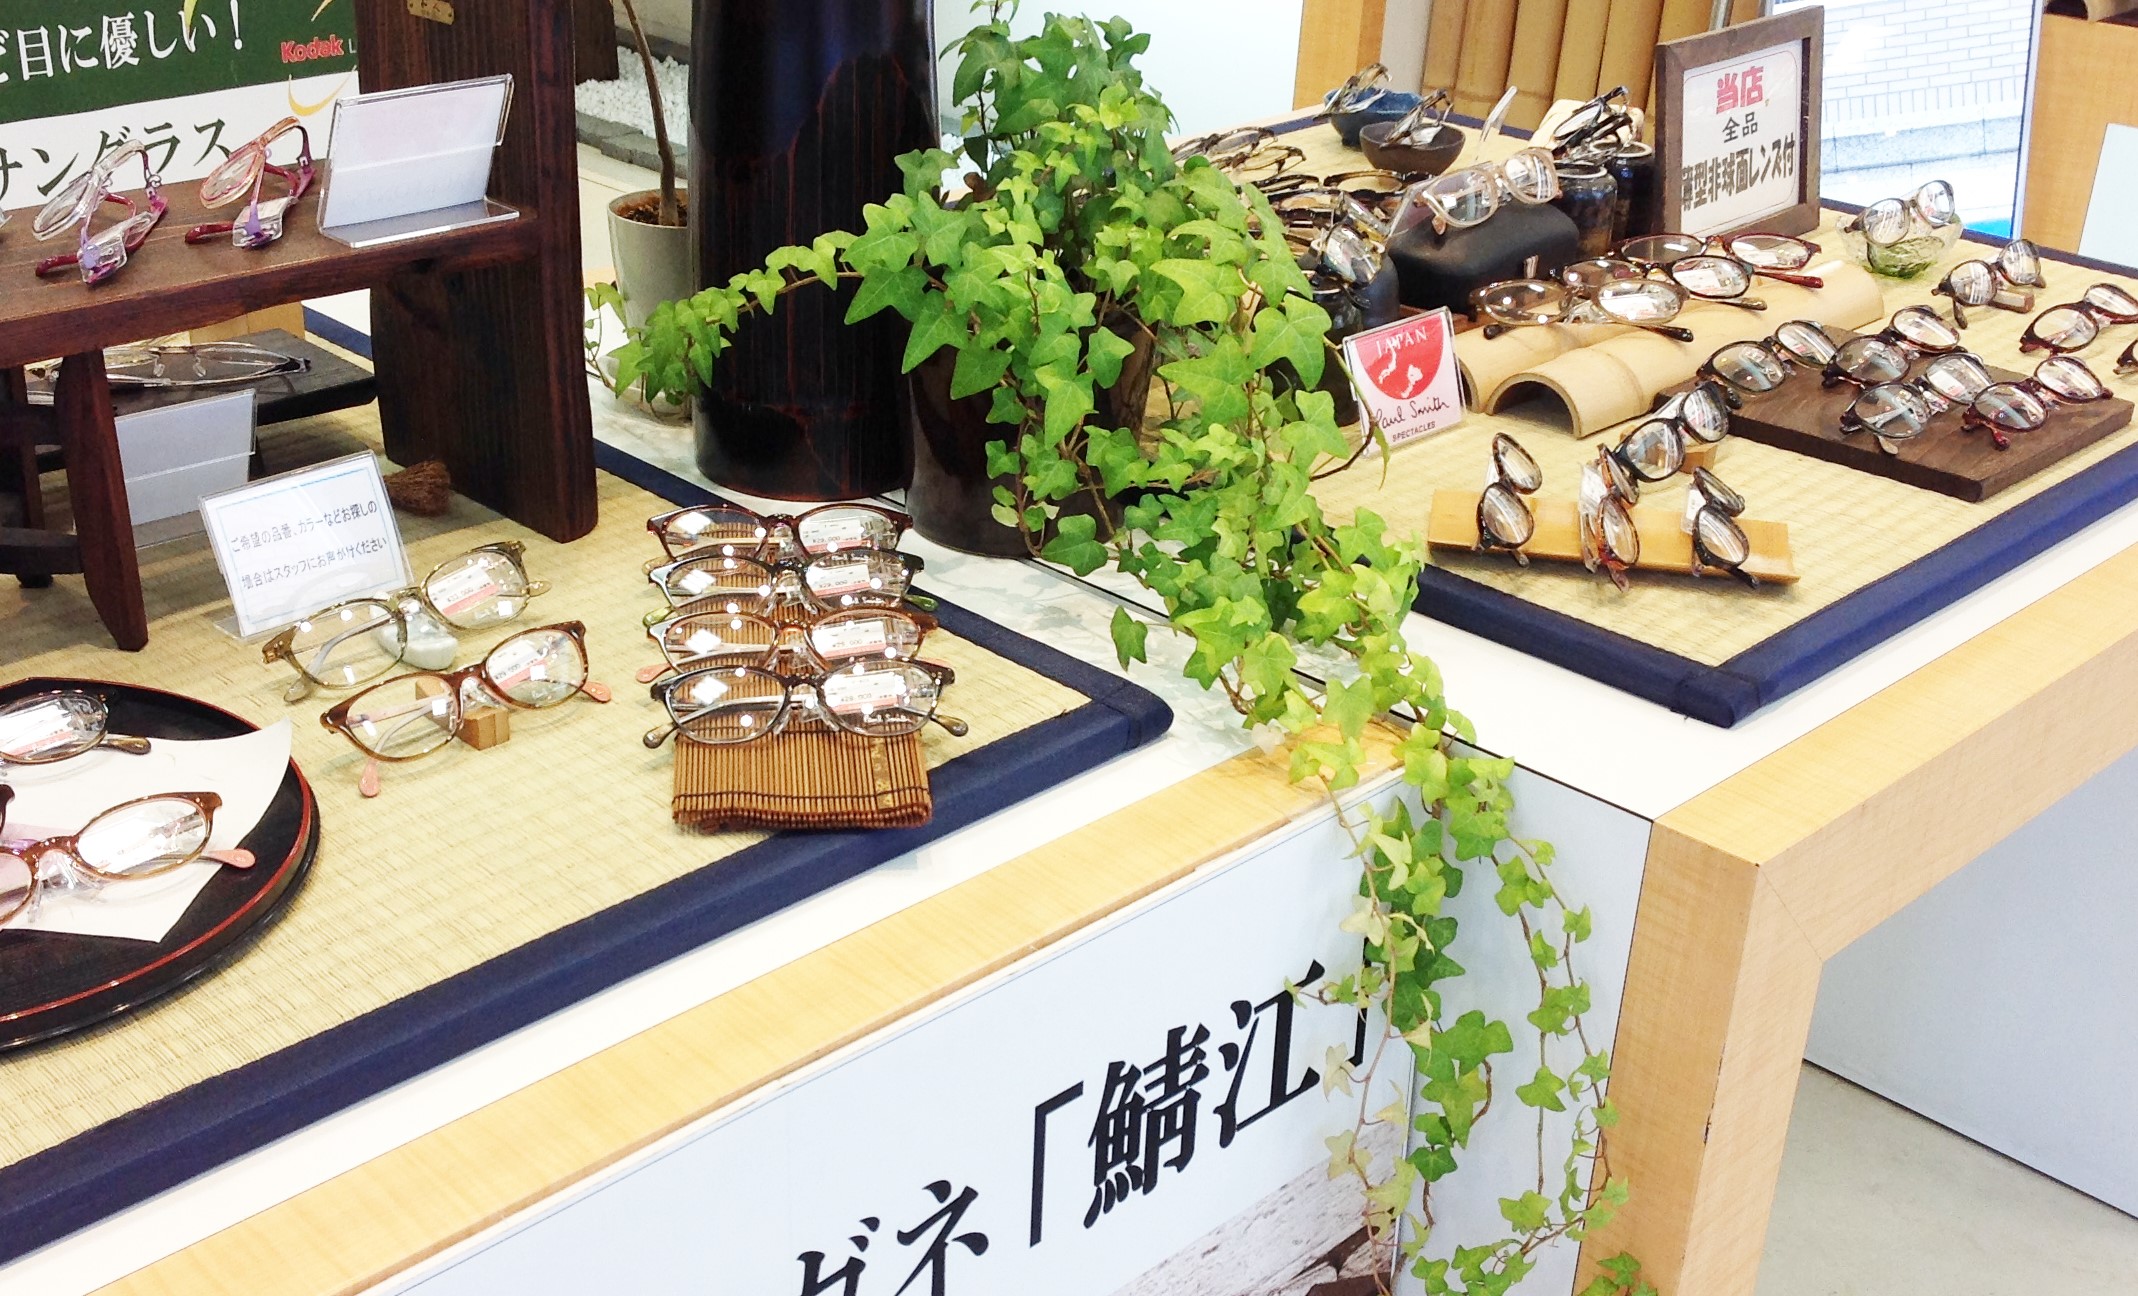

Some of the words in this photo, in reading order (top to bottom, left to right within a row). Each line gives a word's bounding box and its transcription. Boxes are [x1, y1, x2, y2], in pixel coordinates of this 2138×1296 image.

[281, 34, 344, 63] Kodak
[1716, 65, 1764, 114] 当店
[1722, 111, 1758, 143] 全品
[1375, 408, 1405, 429] Paul
[1409, 396, 1450, 418] Smith
[1392, 420, 1436, 442] SPECTACLES
